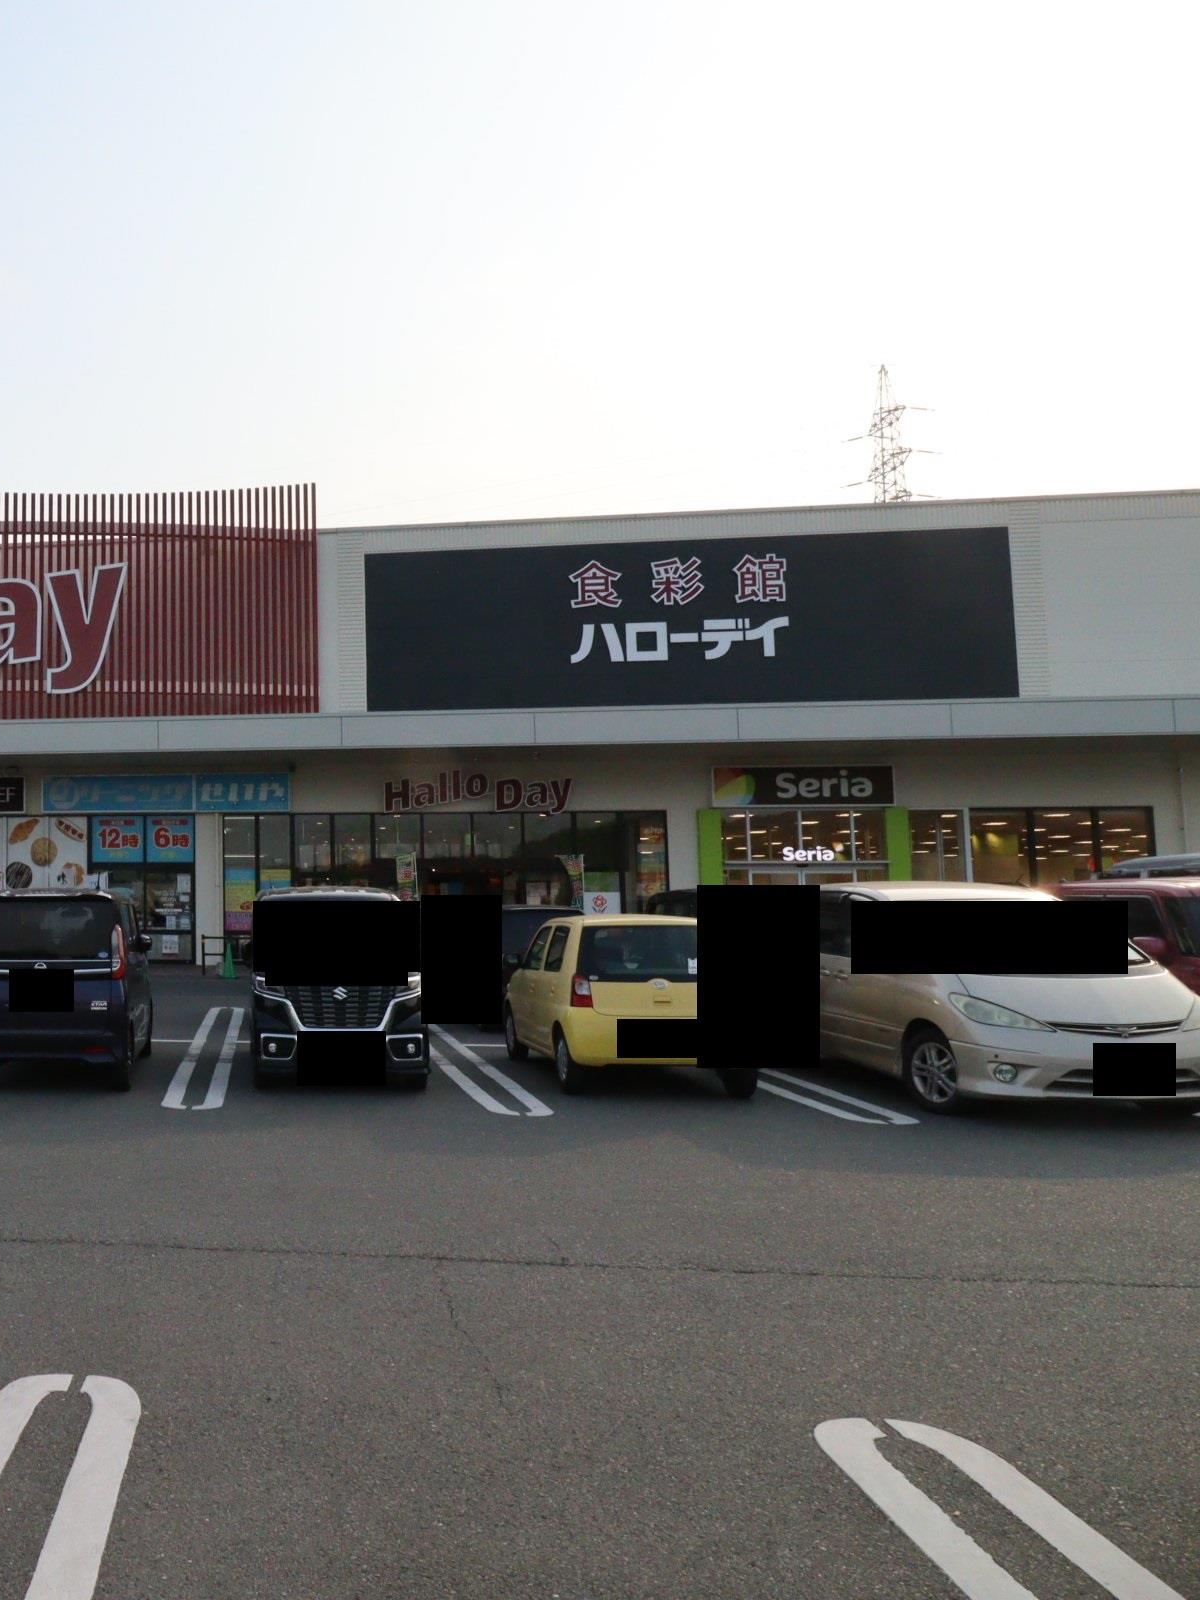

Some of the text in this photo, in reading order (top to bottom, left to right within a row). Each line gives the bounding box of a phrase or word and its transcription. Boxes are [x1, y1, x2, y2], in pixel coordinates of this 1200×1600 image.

[569, 552, 788, 608] 食彩館
[570, 616, 790, 664] ハローデイ
[383, 769, 574, 815] Hallo Day
[775, 769, 873, 800] Seria
[98, 826, 141, 849] 12時
[153, 826, 191, 849] 6時
[782, 846, 835, 862] Seria
